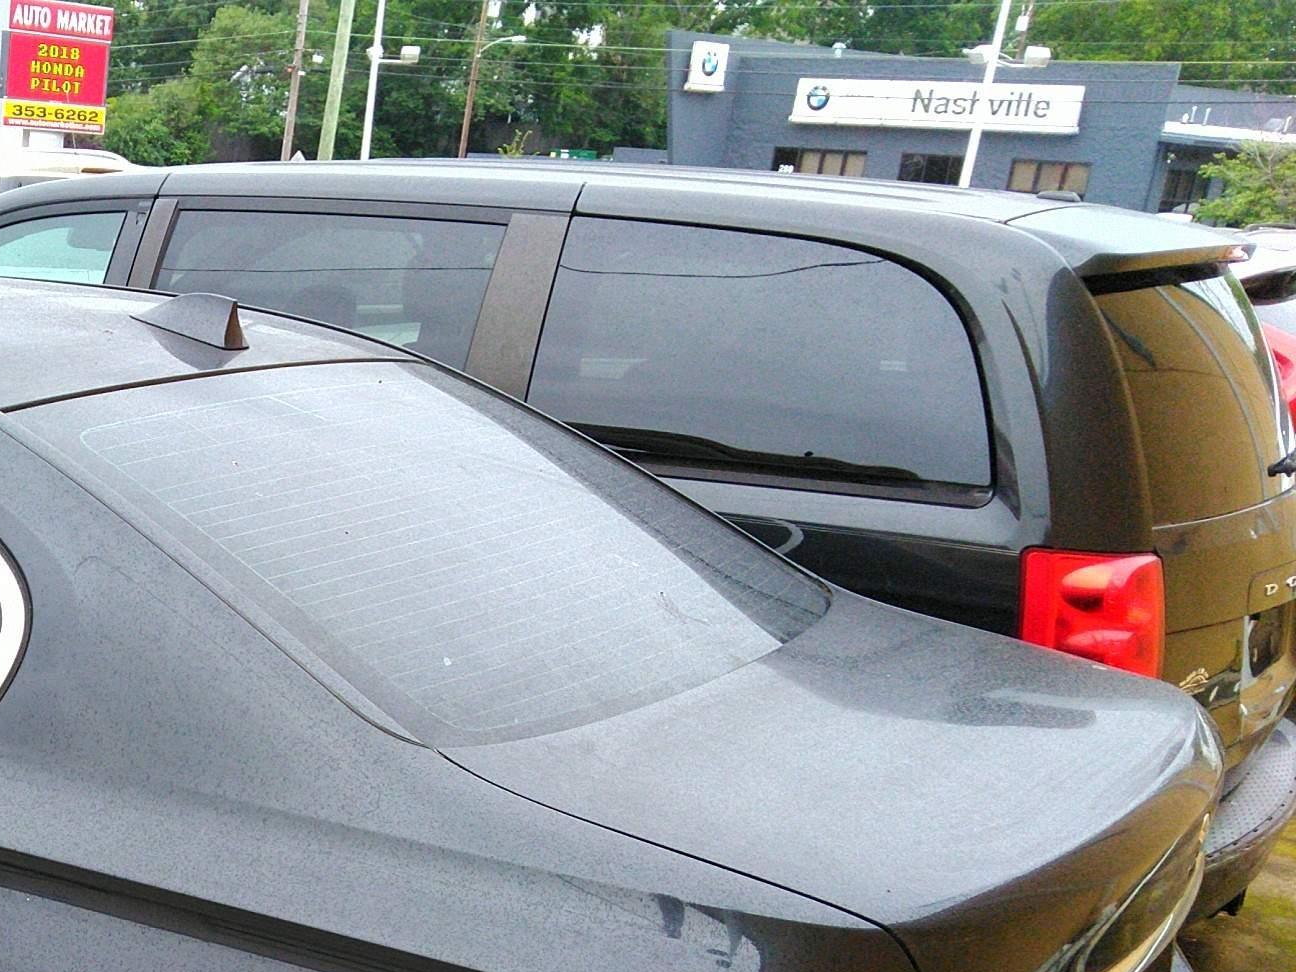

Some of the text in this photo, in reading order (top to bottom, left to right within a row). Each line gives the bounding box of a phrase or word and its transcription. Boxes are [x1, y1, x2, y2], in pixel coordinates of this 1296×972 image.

[12, 4, 112, 35] AUTO MARKET
[38, 43, 80, 60] 2018
[31, 60, 85, 78] HONDA
[30, 77, 81, 94] PILOT
[12, 104, 99, 122] 353-6262
